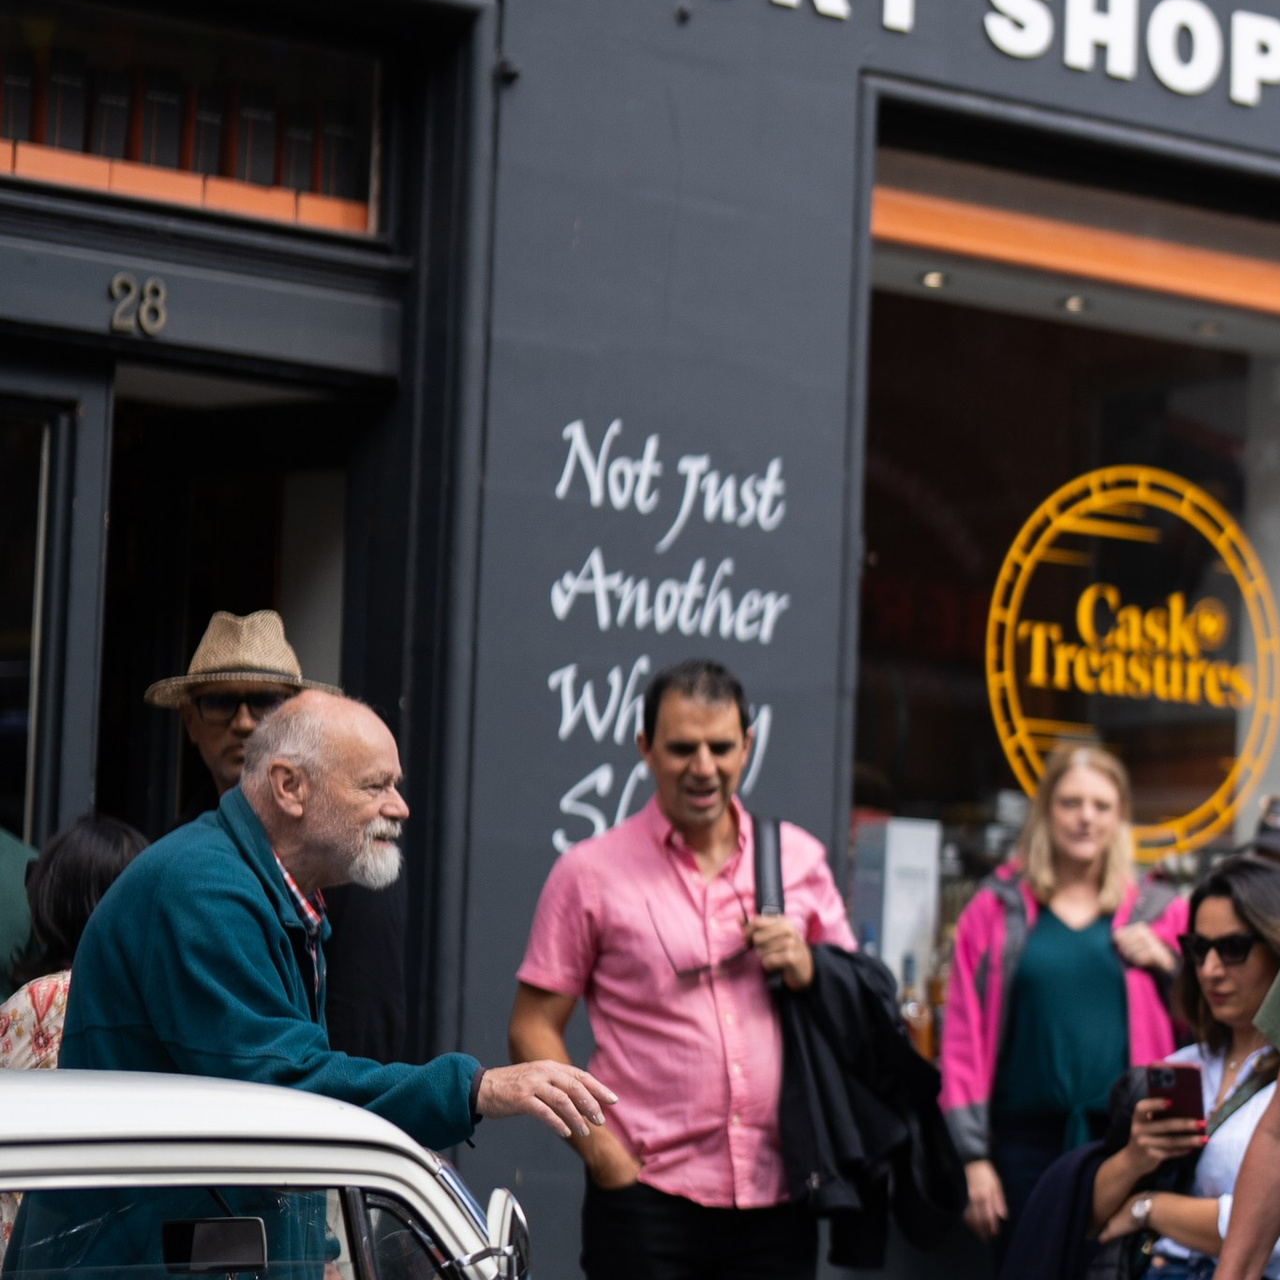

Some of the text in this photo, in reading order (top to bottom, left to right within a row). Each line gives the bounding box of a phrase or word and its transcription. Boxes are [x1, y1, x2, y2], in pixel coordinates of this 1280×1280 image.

[109, 272, 169, 337] 28
[555, 417, 787, 554] Not Just
[550, 546, 790, 645] Another
[1076, 582, 1199, 658] Cask
[1016, 619, 1252, 709] Treasures
